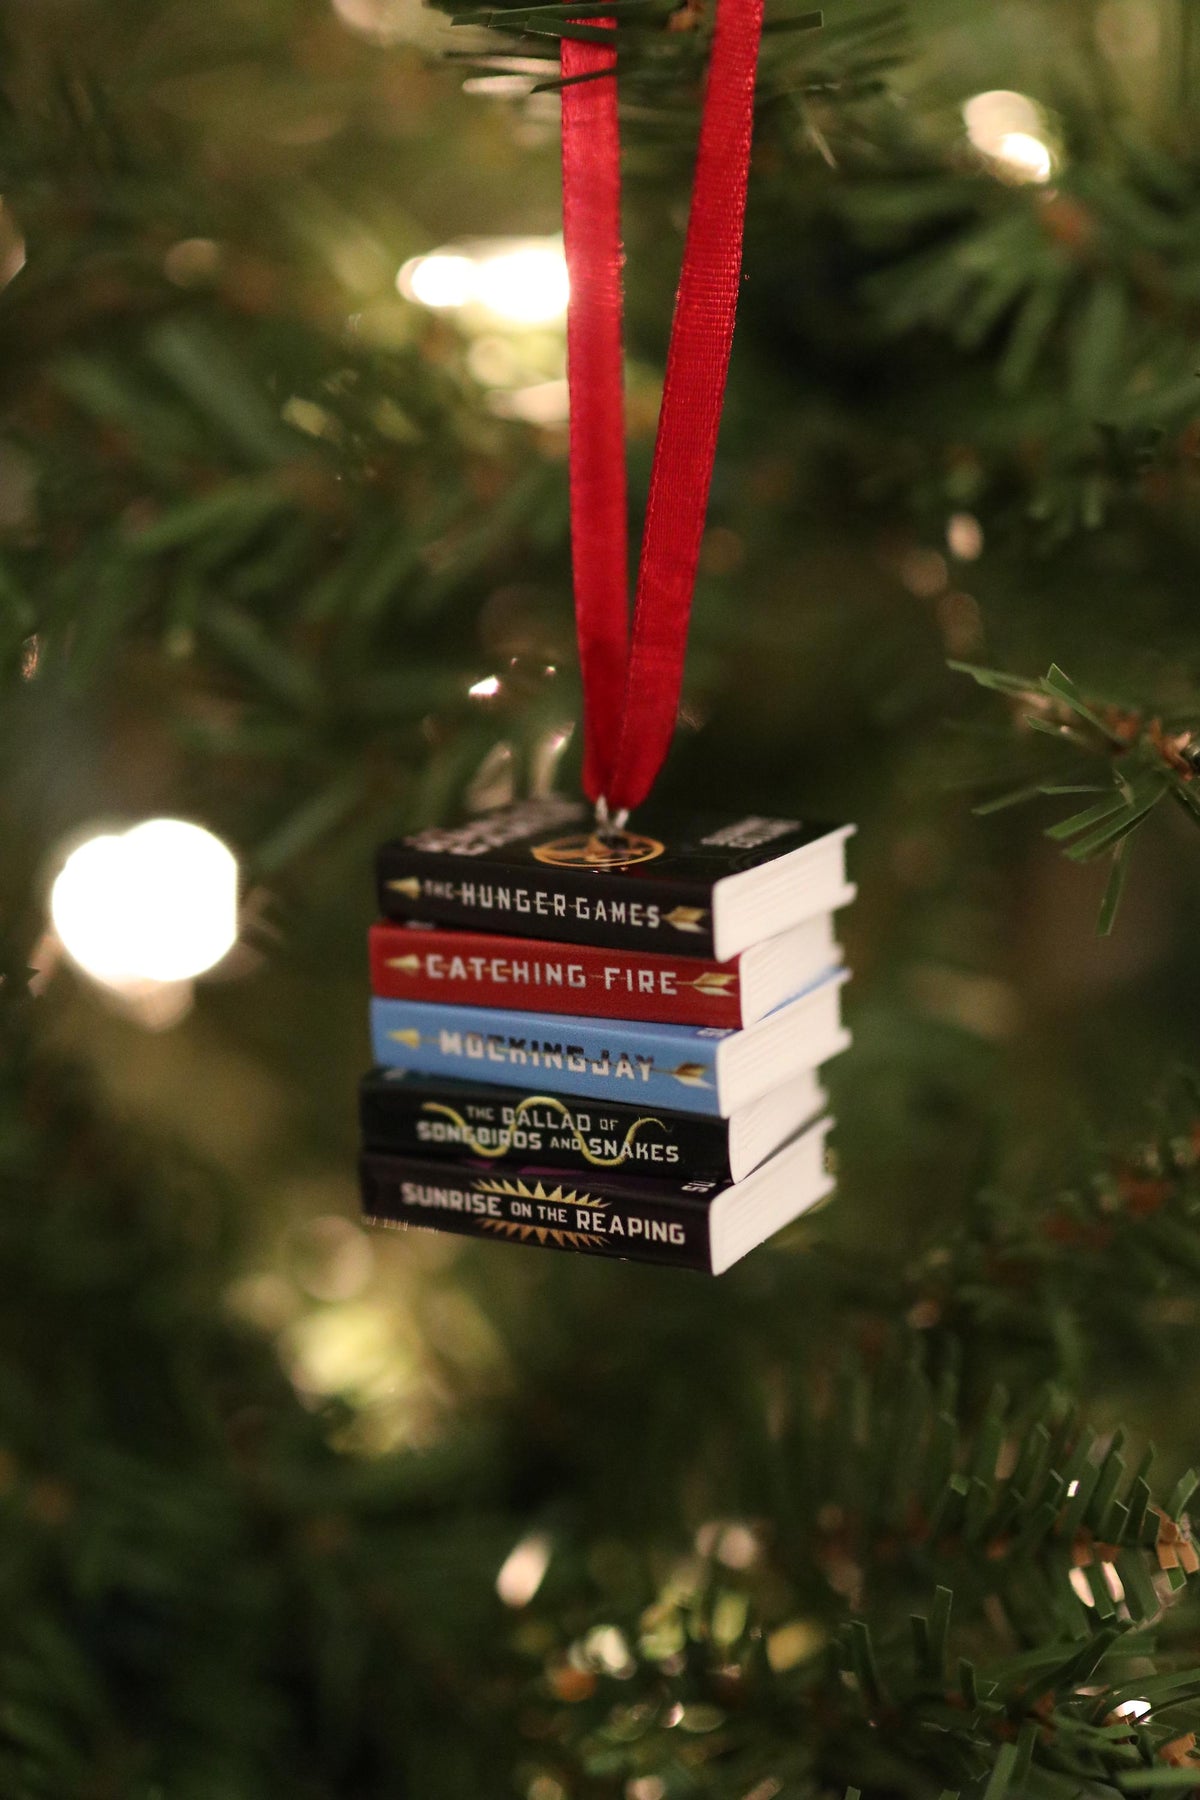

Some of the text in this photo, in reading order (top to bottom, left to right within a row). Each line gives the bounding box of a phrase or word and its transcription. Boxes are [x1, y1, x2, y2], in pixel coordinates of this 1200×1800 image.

[424, 879, 660, 928] THE HUNGER GAMES
[426, 953, 677, 995] CATCHING FIRE
[439, 1029, 654, 1082] MOCKINGJAY
[417, 1120, 680, 1162] SONGBIRDS AND SNAKES
[466, 1105, 619, 1132] THE BALLAD OF
[401, 1182, 686, 1245] SUNRISE ON THE REAPING
